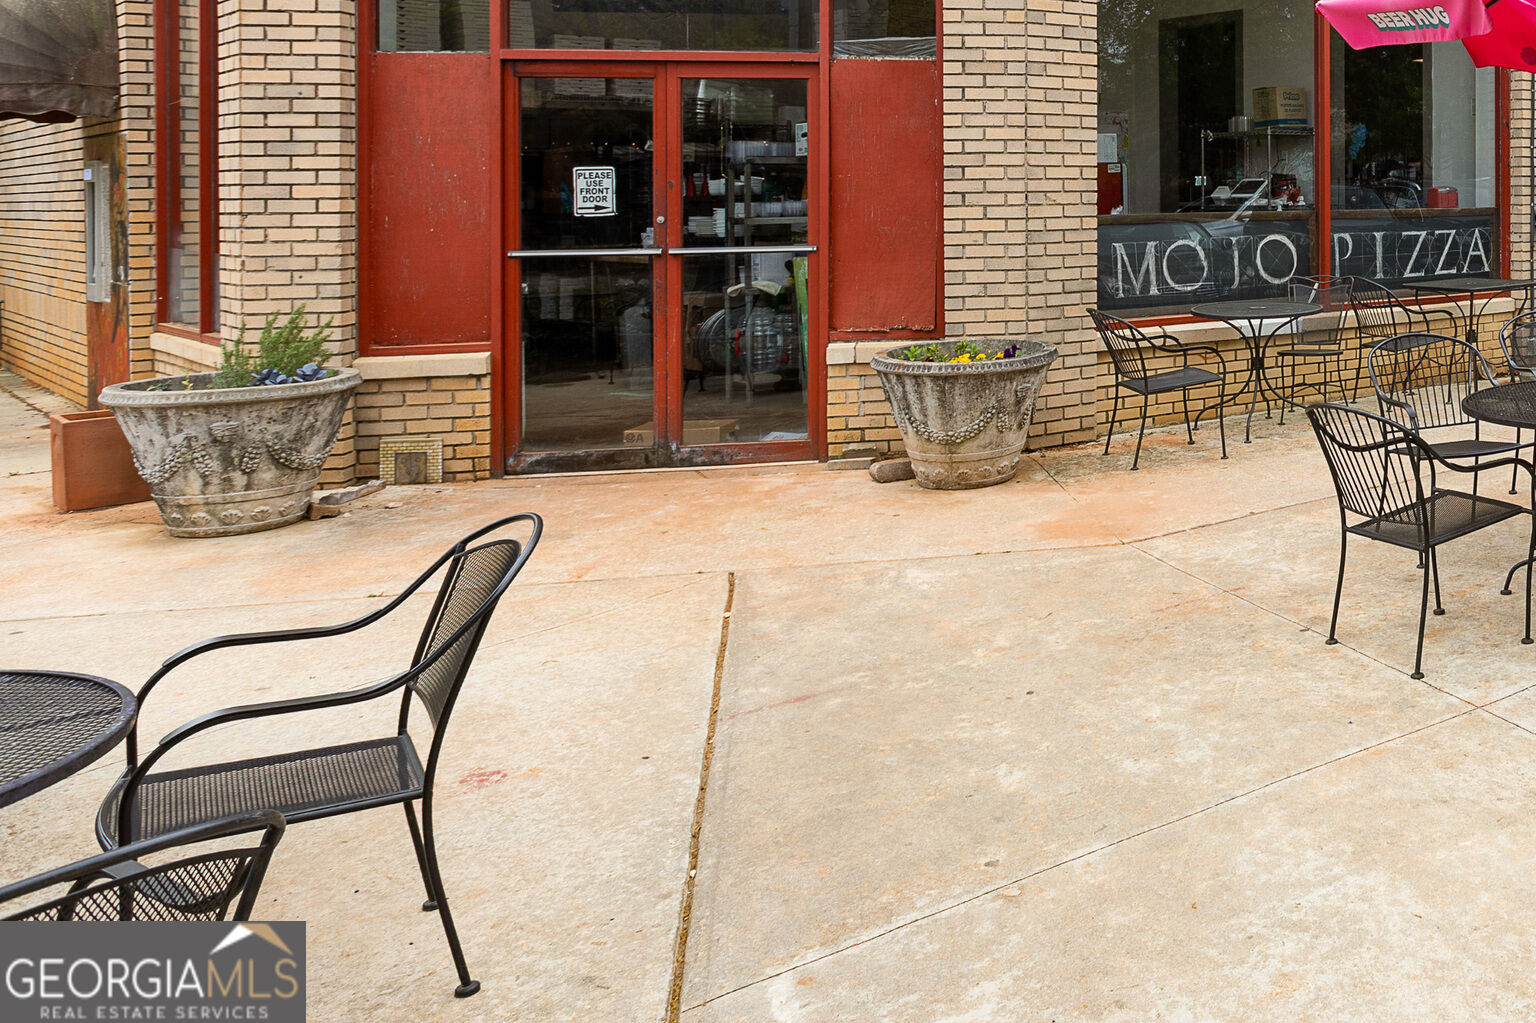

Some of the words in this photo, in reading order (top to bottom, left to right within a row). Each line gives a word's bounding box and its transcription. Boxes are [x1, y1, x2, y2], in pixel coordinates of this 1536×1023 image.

[1367, 10, 1416, 31] BEER
[1407, 5, 1450, 28] HUG
[577, 171, 612, 180] PLEASE
[585, 179, 604, 187] USE
[580, 187, 610, 195] FRONT
[582, 195, 608, 203] DOOR
[1111, 233, 1299, 299] MOJO
[1332, 227, 1492, 279] PIZZA
